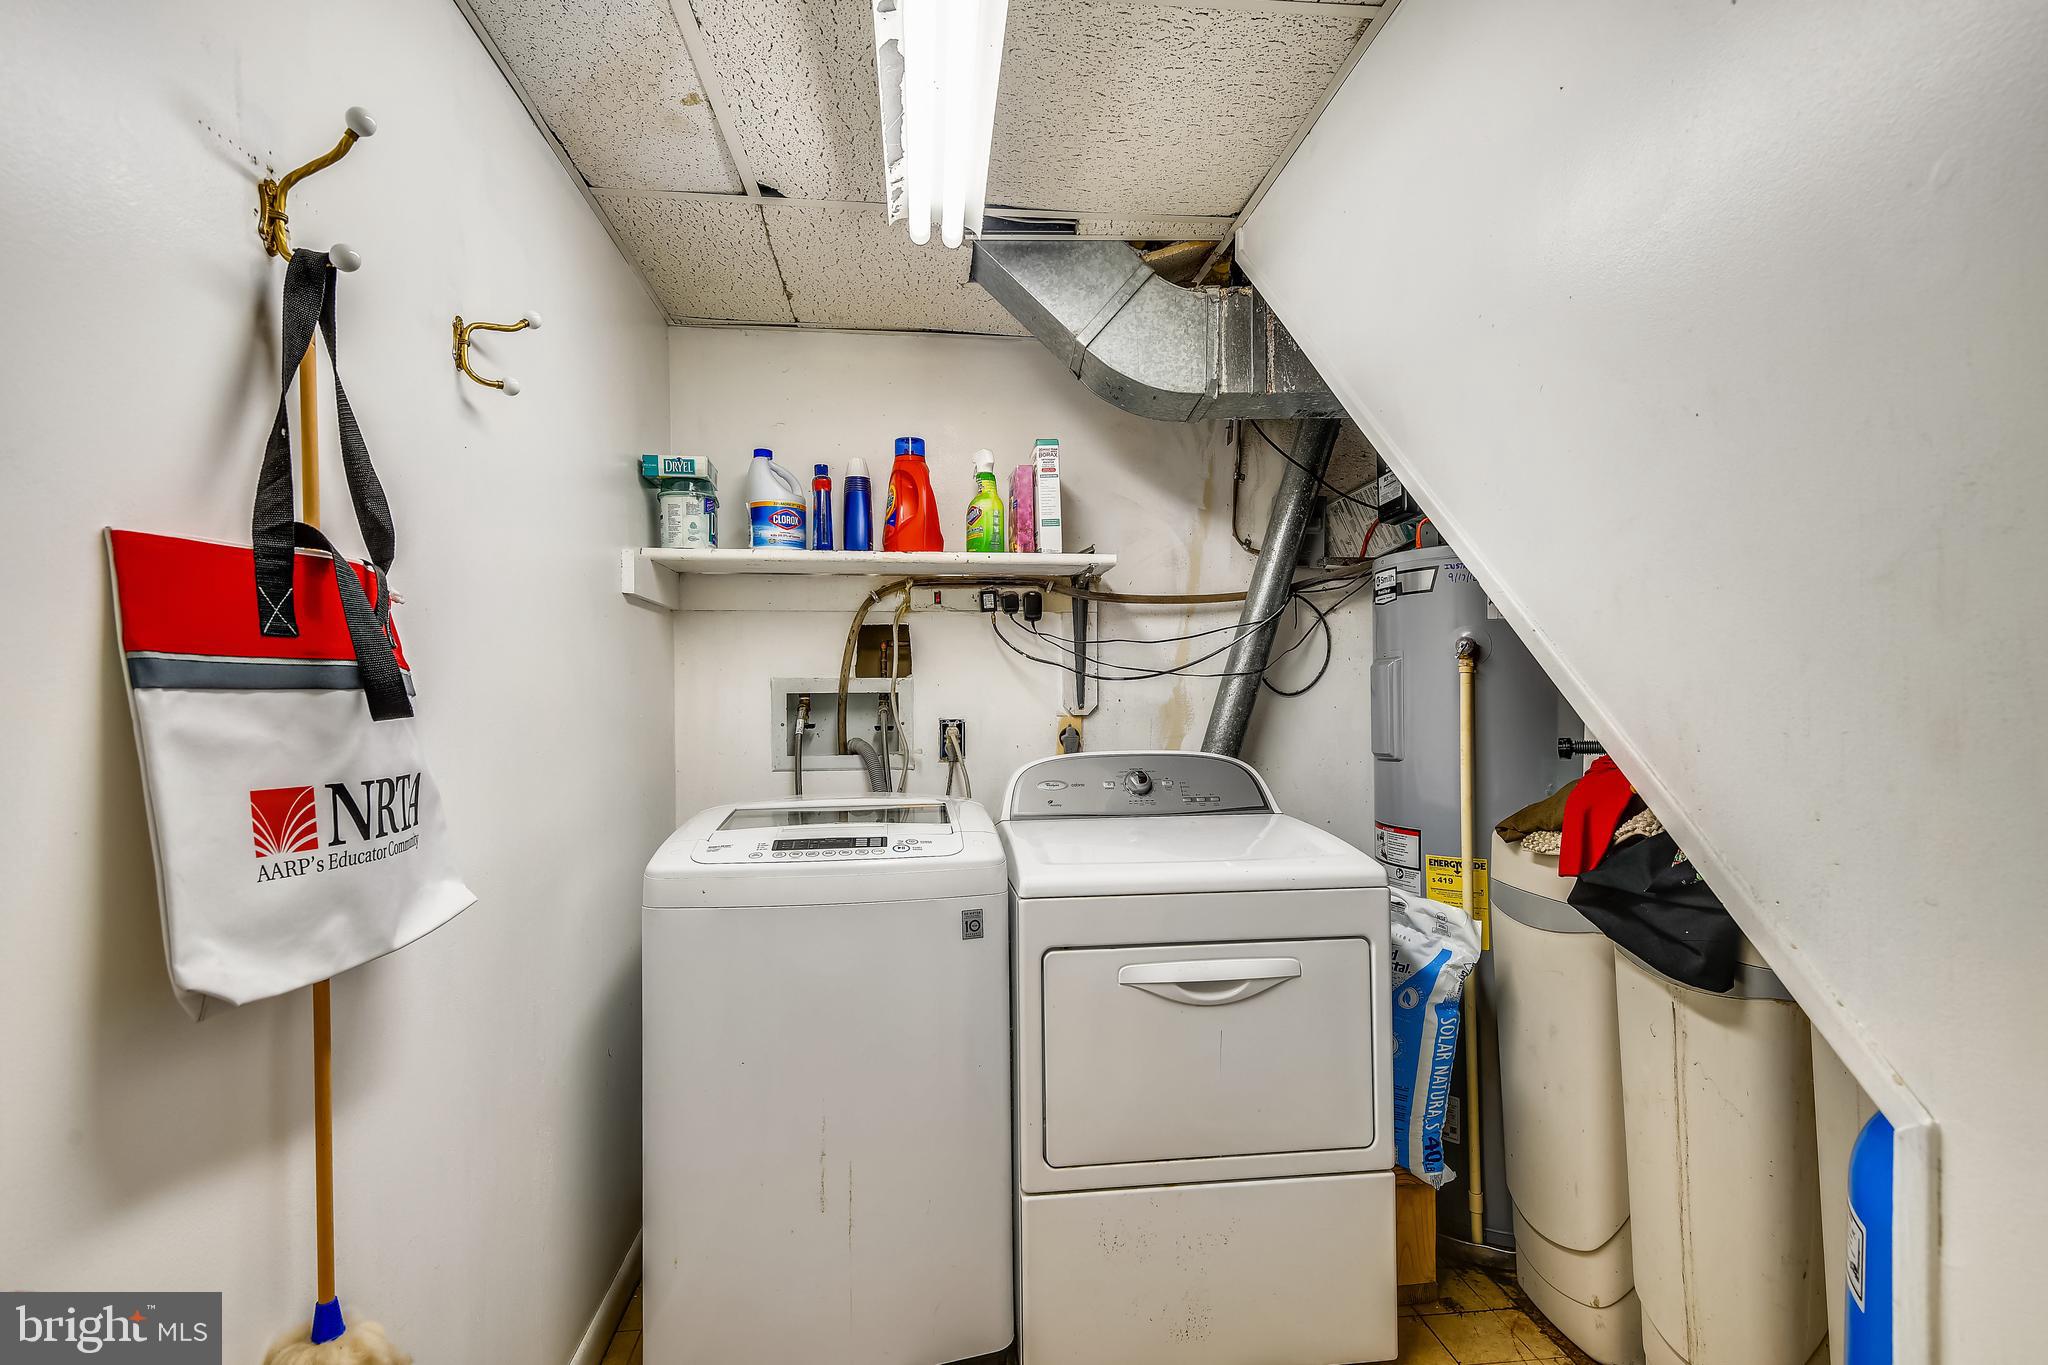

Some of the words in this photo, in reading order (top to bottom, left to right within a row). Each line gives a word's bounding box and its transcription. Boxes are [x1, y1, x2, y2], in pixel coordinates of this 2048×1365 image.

[665, 460, 694, 473] DRYEL
[773, 514, 799, 526] CLOROX
[324, 772, 421, 847] NRTA
[256, 855, 325, 883] AARP's
[328, 847, 388, 871] Educator
[1435, 1017, 1457, 1061] SOLAR
[1424, 1136, 1443, 1163] 40
